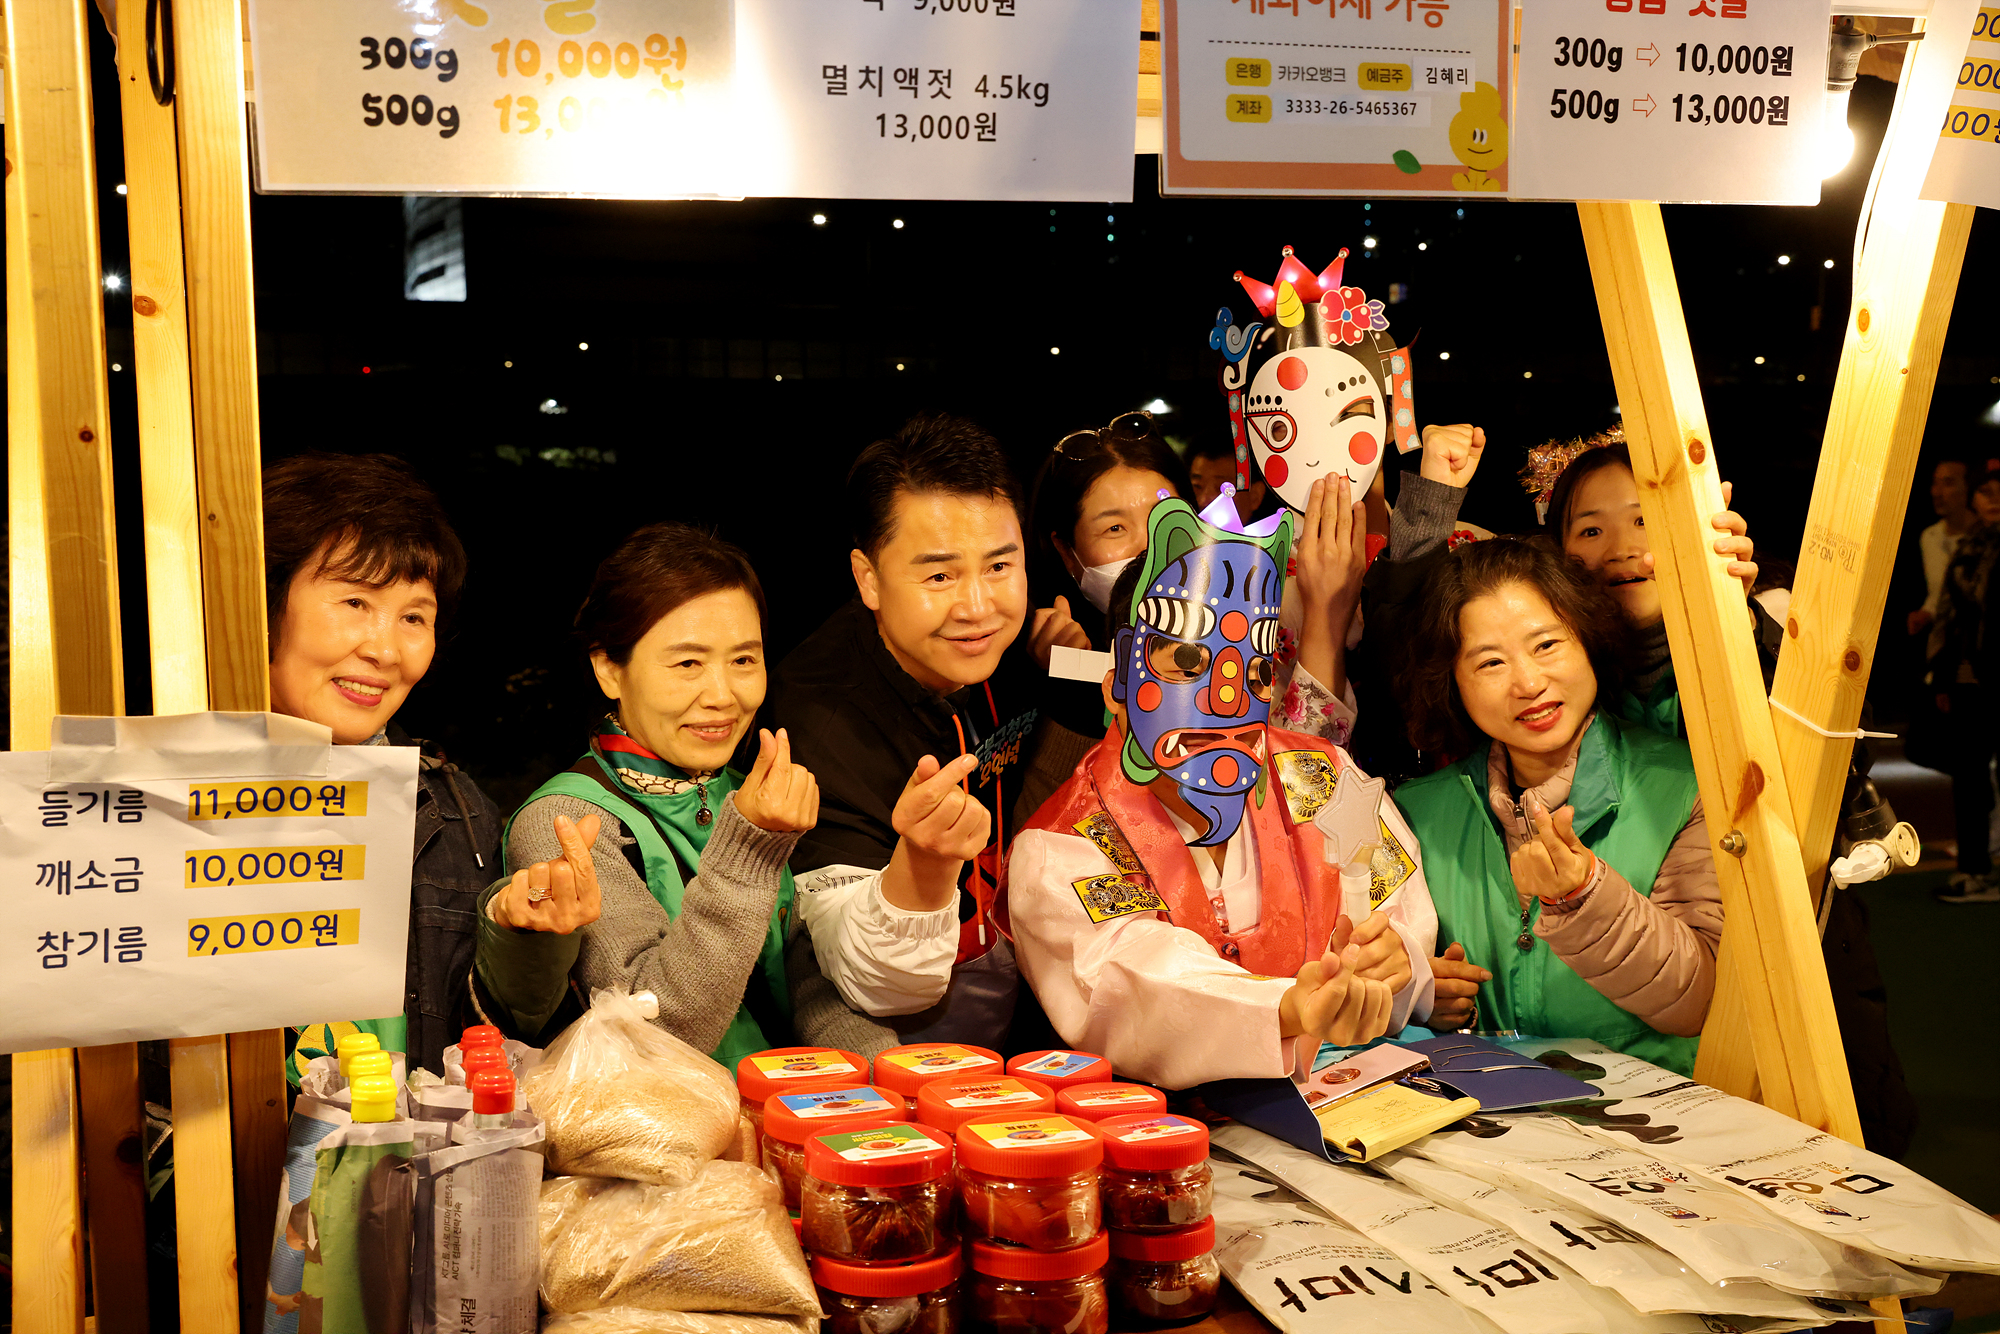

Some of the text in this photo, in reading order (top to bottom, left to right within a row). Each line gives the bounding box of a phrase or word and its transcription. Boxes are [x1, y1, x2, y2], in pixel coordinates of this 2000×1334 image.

[360, 32, 688, 91] 300g 10,000원
[1235, 64, 1469, 85] 은행 카카오뱅크 예금주 김혜리
[1553, 36, 1624, 73] 300g
[1675, 42, 1794, 77] 10,000원
[822, 64, 1050, 108] 멸치액젓 4.5kg
[362, 92, 460, 139] 500g
[875, 112, 997, 142] 13,000원
[1236, 99, 1418, 117] 계좌 3333-26-5465367
[1550, 88, 1790, 127] 500g 13,000원
[38, 784, 347, 827] 들기름 11,000원
[35, 848, 344, 896] 깨소금 10,000원
[37, 914, 339, 969] 참기름 9,000원
[452, 1261, 460, 1280] AICT
[460, 1298, 476, 1326] 체결
